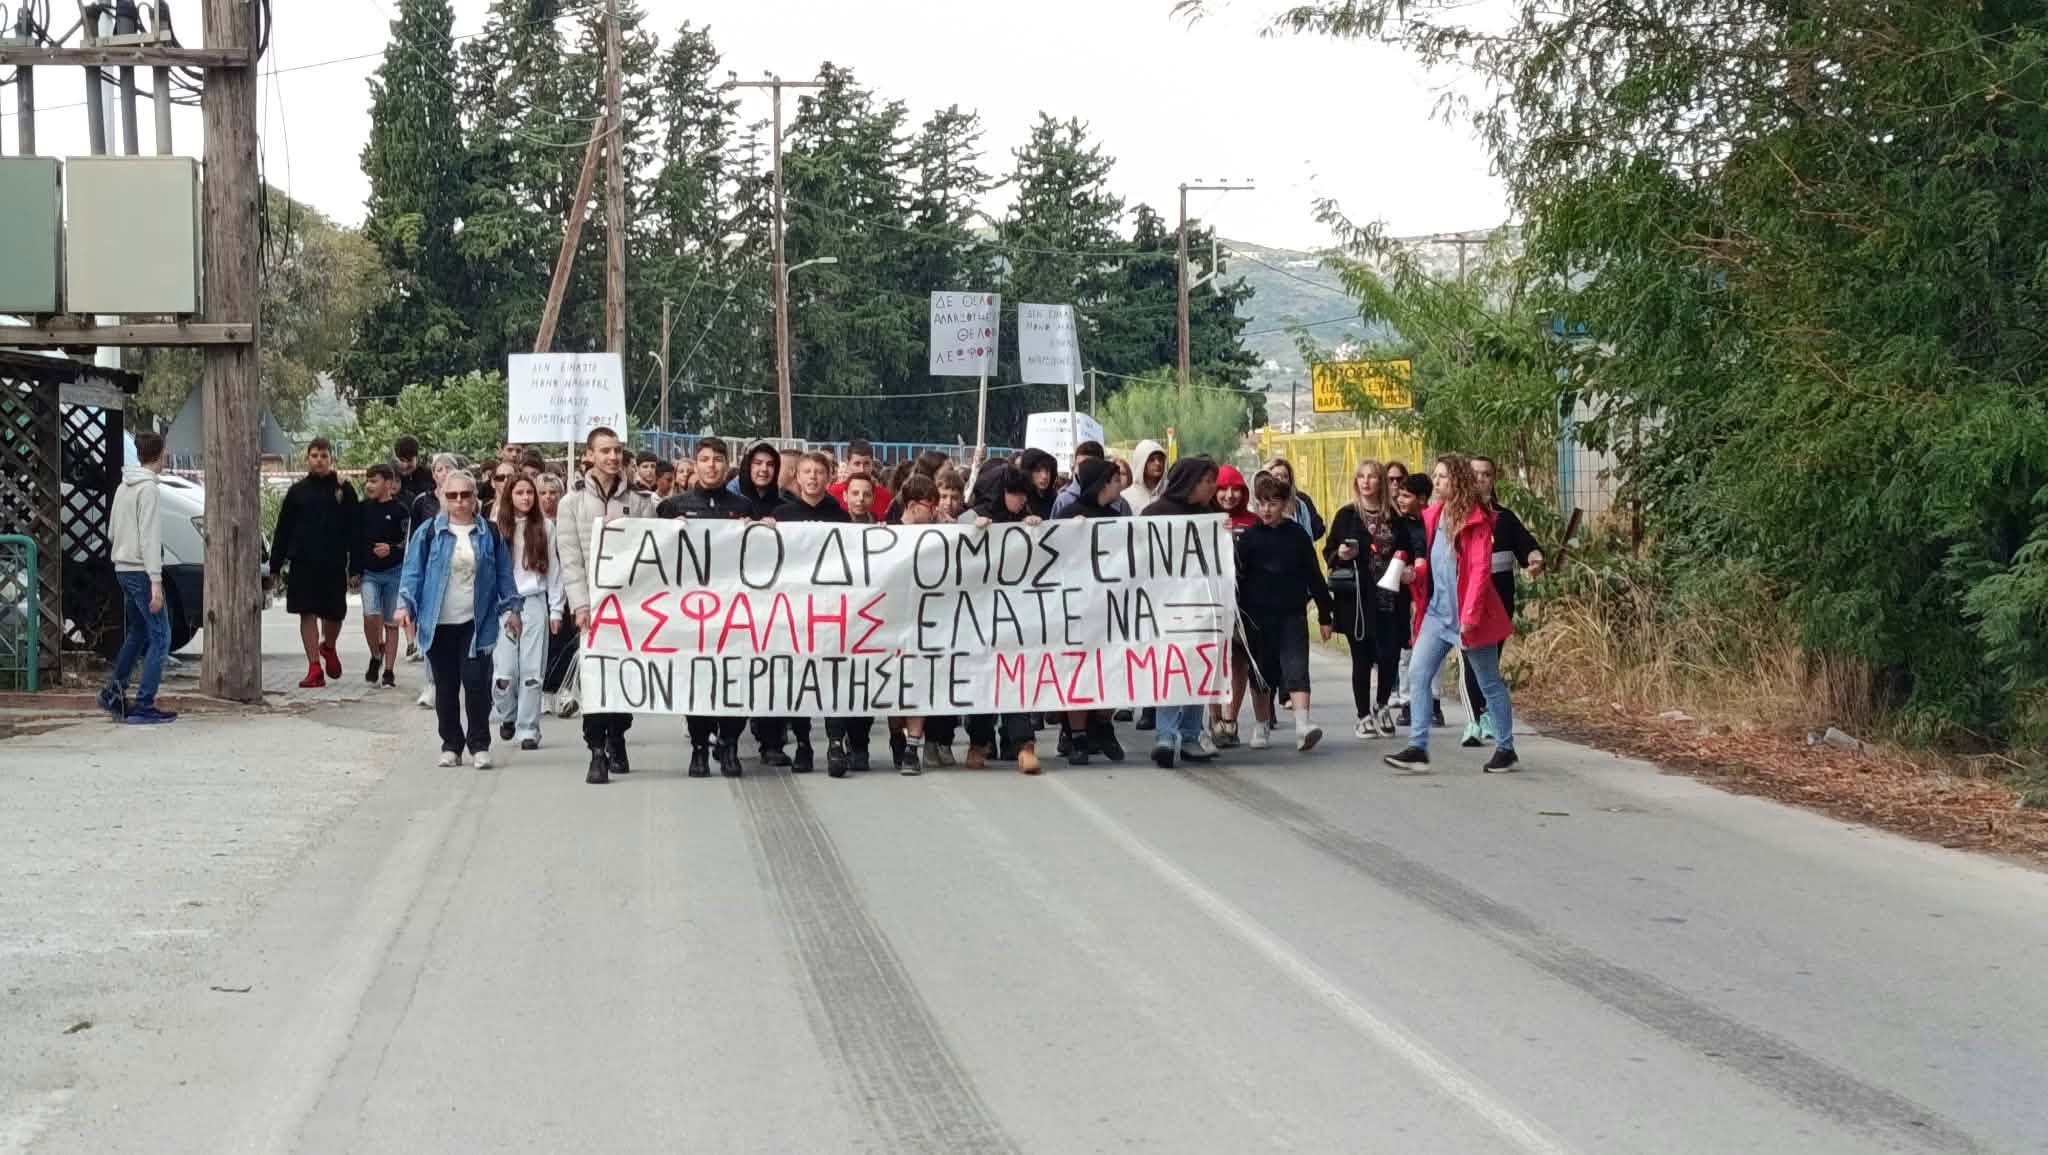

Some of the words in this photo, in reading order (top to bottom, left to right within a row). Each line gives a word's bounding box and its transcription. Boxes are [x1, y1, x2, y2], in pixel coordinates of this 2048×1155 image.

[595, 526, 711, 589] ΕΑΝ
[739, 523, 785, 590] Ο
[811, 524, 1061, 589] ΔΡΟΜΟΣ
[1091, 520, 1222, 583] ΕΙΝΑΙ
[917, 587, 1083, 651] ΕΛΑΤΕ
[1106, 587, 1160, 643] ΝΑ
[585, 655, 673, 711] ΤΟΝ
[689, 651, 974, 711] ΠΕΡΠΑΤΗΣΕΤΕ
[994, 648, 1104, 709] ΜΑΖΙ
[1125, 639, 1230, 702] ΜΑΣ!
